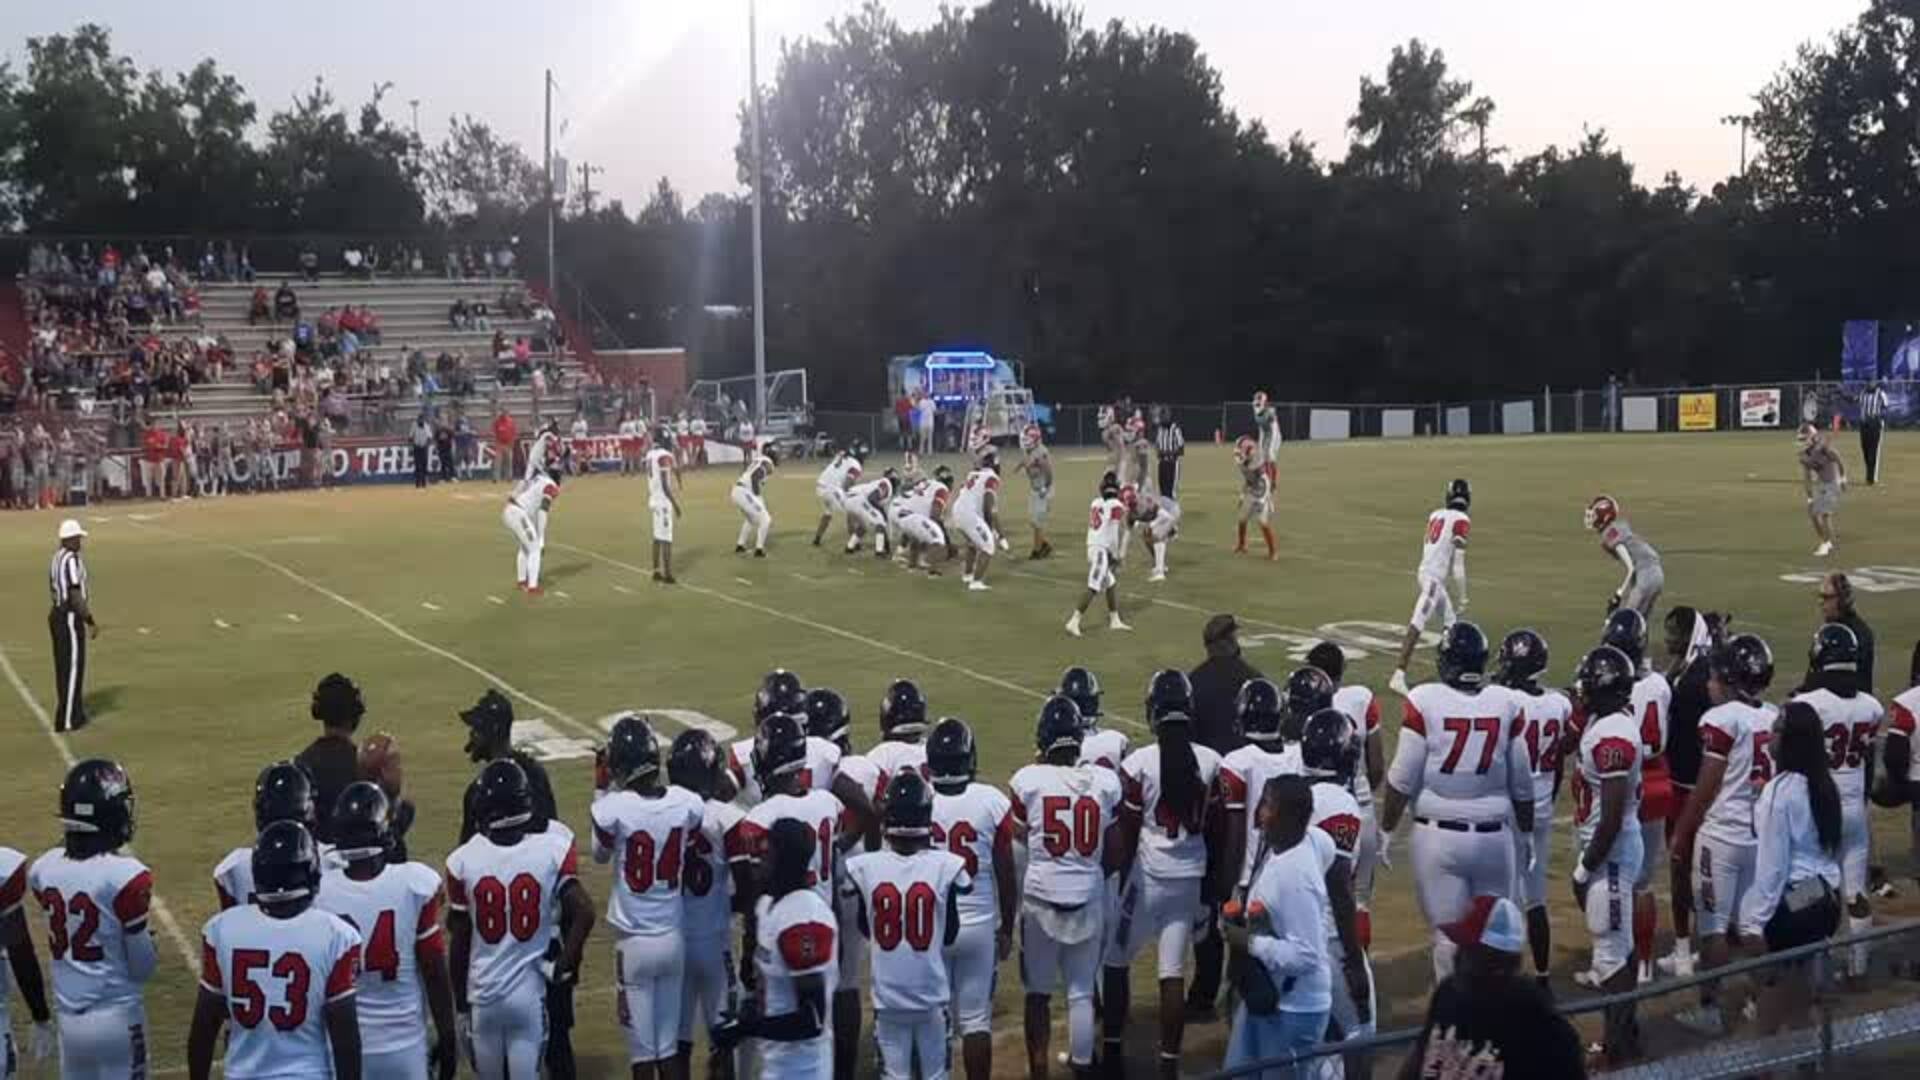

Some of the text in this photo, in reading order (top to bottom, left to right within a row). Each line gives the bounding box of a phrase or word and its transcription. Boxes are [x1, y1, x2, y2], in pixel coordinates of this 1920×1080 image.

[356, 446, 416, 476] THE
[1439, 717, 1500, 774] 77
[1750, 730, 1775, 784] 5
[1825, 722, 1880, 769] 35
[931, 820, 979, 881] 6
[1043, 795, 1100, 857] 50
[624, 826, 683, 893] 84
[40, 887, 104, 961] 32
[474, 872, 541, 944] 88
[872, 881, 935, 951] 80
[339, 909, 399, 981] 4
[231, 948, 310, 1031] 53
